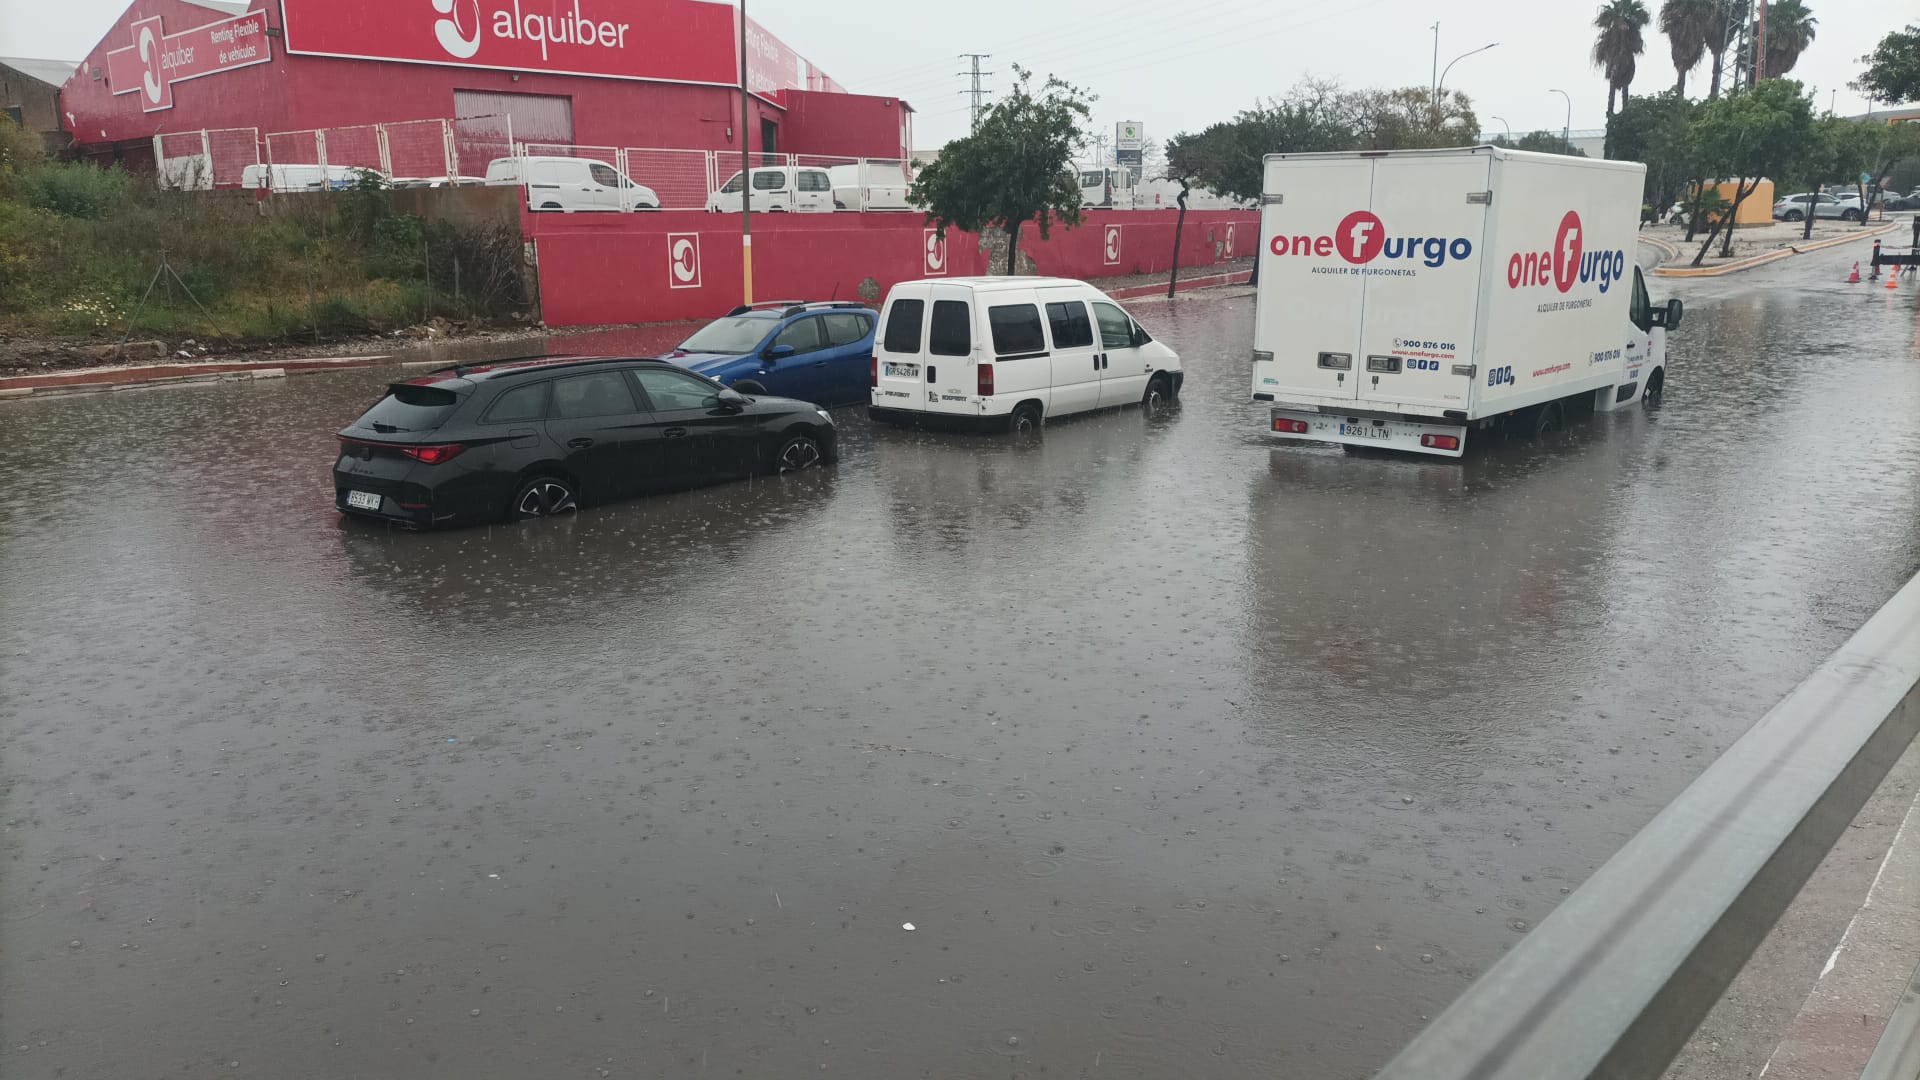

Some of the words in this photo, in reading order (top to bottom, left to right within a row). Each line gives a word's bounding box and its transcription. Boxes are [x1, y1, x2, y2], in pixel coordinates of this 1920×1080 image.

[210, 27, 234, 43] Renting
[234, 19, 259, 39] Flexible
[493, 0, 629, 61] alquiber
[161, 37, 194, 77] alquiber
[219, 51, 227, 64] de
[1312, 267, 1348, 275] ALQUILER
[1350, 268, 1360, 276] DE
[1362, 269, 1416, 277] FURGONETAS
[1537, 302, 1559, 313] ALQUILER
[1403, 340, 1421, 348] 900
[1423, 341, 1438, 349] 876
[1440, 342, 1456, 350] 016
[1392, 349, 1455, 359] www.onefurgo.com
[1346, 425, 1369, 437] 9261
[1371, 428, 1389, 439] LTN
